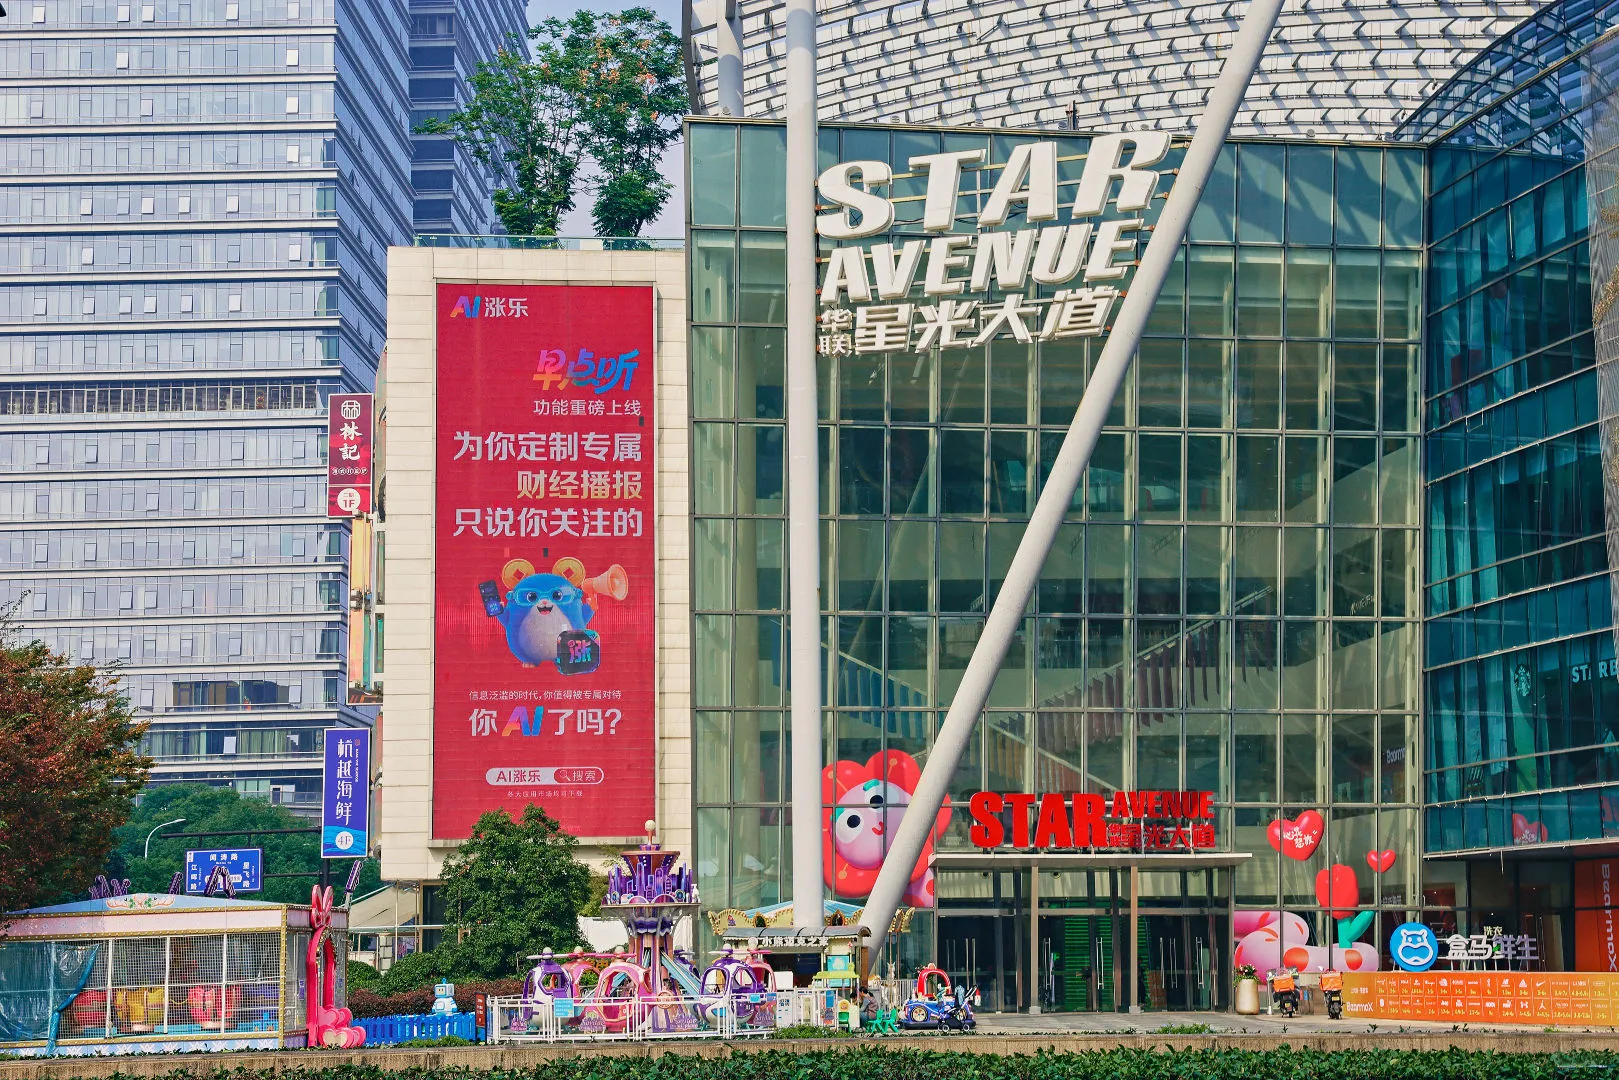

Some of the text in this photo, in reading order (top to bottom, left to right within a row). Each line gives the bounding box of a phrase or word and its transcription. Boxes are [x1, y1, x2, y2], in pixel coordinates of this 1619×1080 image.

[816, 130, 1172, 240] STAR
[820, 218, 1145, 305] AVENUE
[533, 348, 640, 394] 早点听
[534, 400, 641, 416] 功能重磅上线
[453, 431, 642, 461] 为你定制专属
[517, 470, 642, 500] 财经播报
[343, 499, 355, 508] 1F
[453, 507, 642, 537] 只说你关注的
[336, 738, 353, 825] 杭越海鲜
[496, 769, 540, 783] AI涨乐
[573, 770, 596, 782] 搜索
[969, 791, 1215, 848] STAR AVENUE
[337, 834, 351, 845] 4F
[1483, 925, 1503, 936] 洗衣
[1446, 934, 1539, 960] 盒马鲜生
